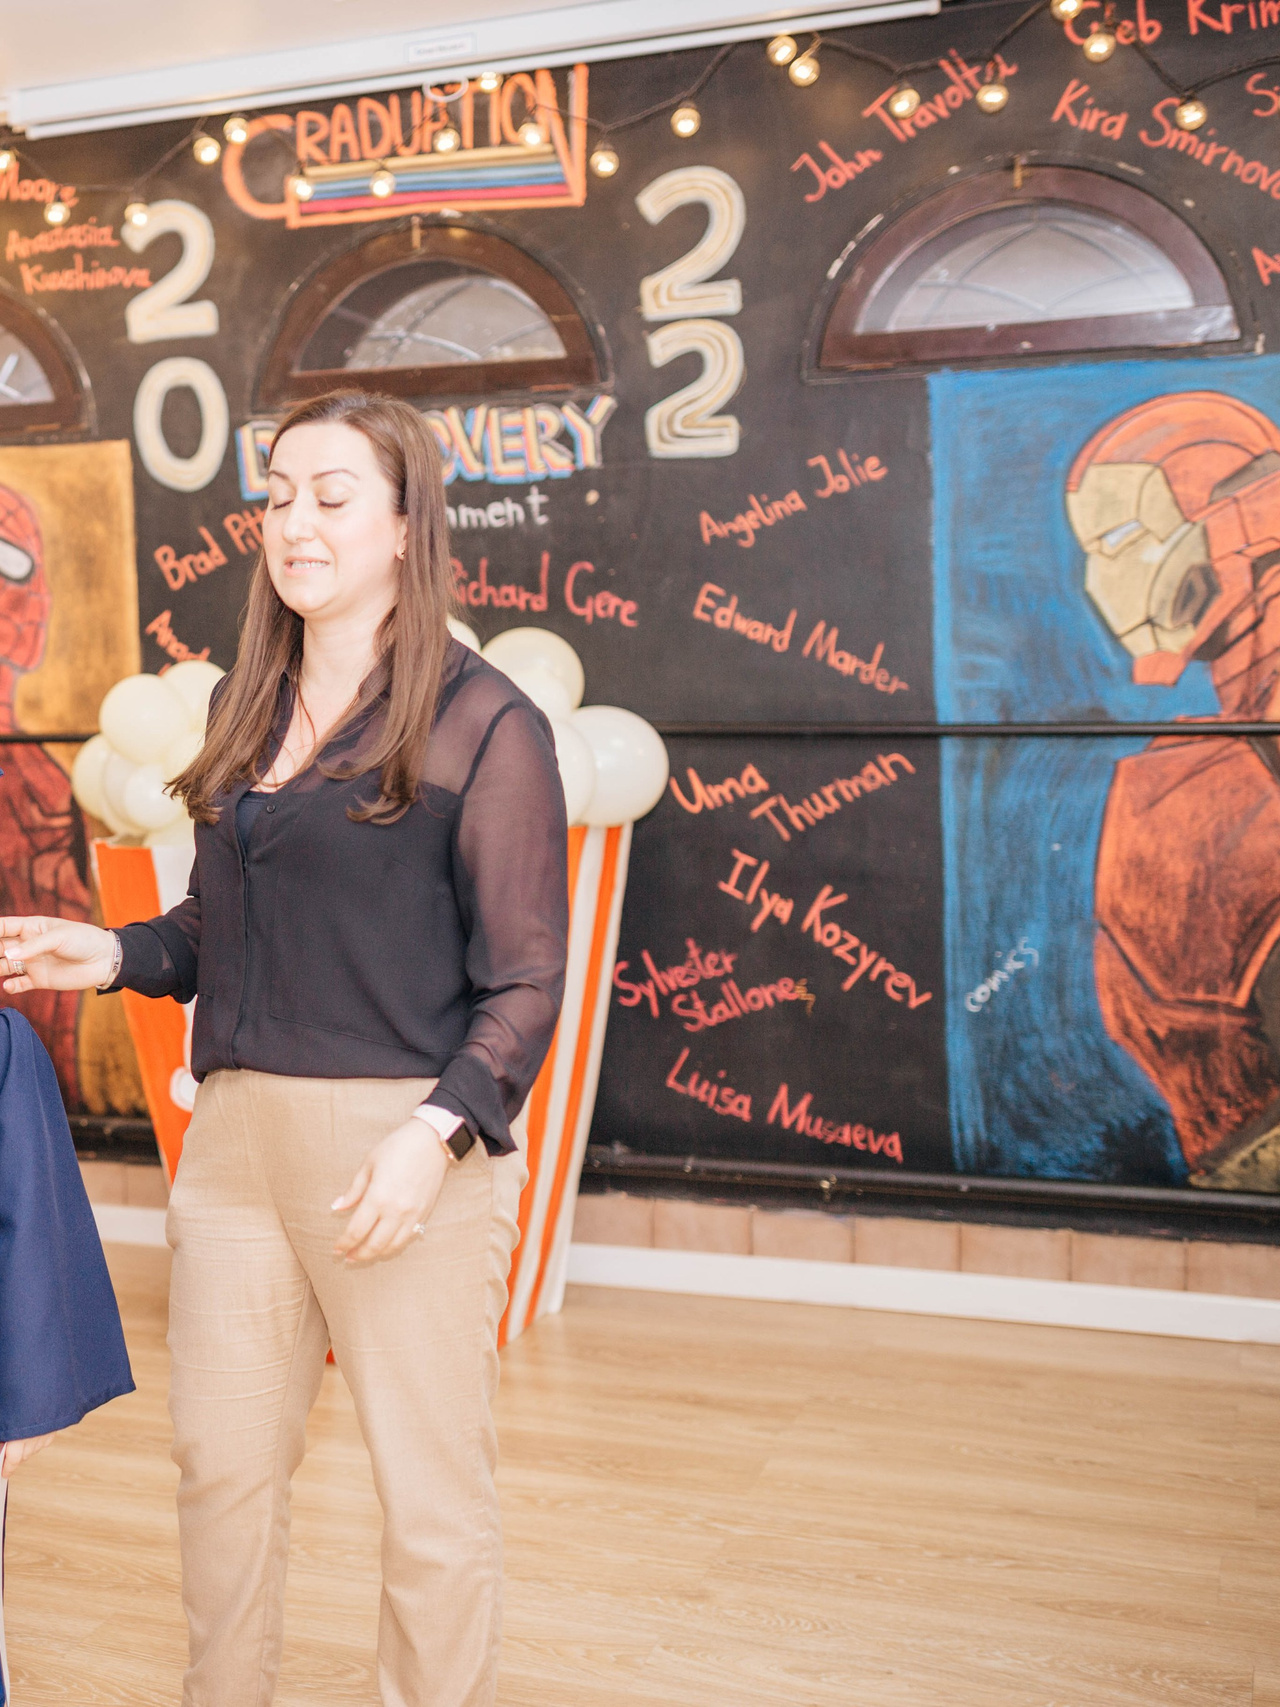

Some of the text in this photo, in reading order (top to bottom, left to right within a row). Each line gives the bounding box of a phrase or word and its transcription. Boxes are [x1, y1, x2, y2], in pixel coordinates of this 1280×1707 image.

[1050, 77, 1130, 141] Kira
[789, 140, 884, 204] John
[699, 447, 889, 548] Angelina Jolie
[154, 525, 229, 591] Brad
[448, 550, 639, 627] Richard Gere
[692, 581, 910, 695] Edward Marder
[670, 762, 769, 814] Uma
[749, 752, 916, 842] Thurman
[717, 847, 933, 1009] Ilya Kozyrev
[612, 937, 739, 1018] Sylvester
[672, 977, 800, 1033] Stallone
[665, 1046, 753, 1122] Luisa
